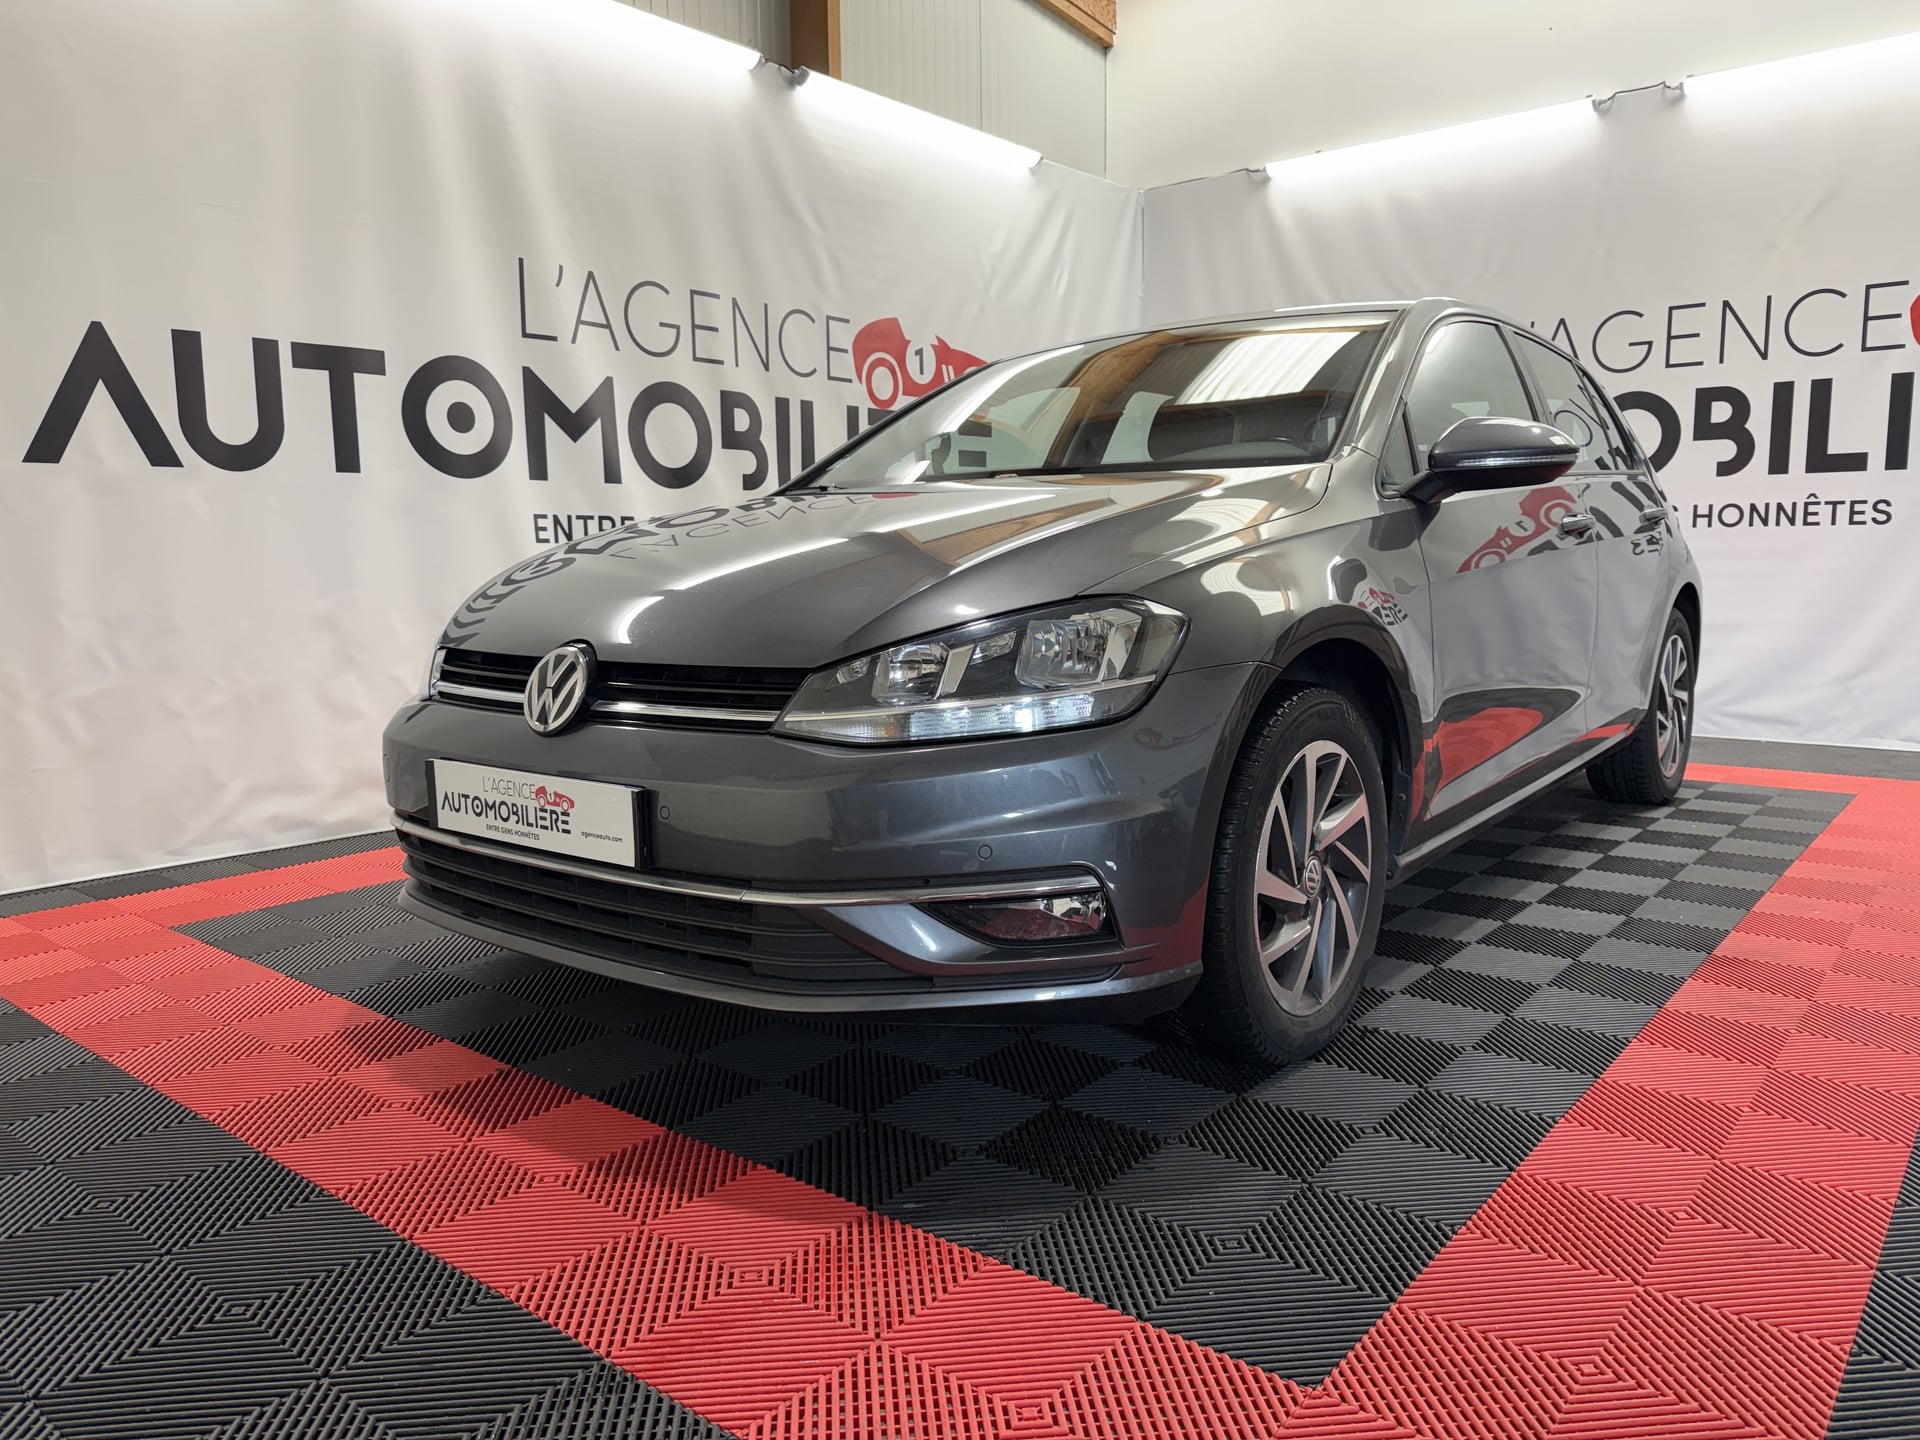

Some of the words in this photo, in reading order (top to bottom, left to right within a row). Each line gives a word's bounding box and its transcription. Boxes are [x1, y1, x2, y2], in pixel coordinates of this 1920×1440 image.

[518, 257, 854, 384] L'AGENCE
[1691, 493, 1893, 529] HONNÊTES
[482, 776, 536, 801] L'AGENCE
[486, 823, 501, 833] ENTRE
[501, 826, 514, 836] GENS
[580, 831, 624, 843] agenceauto.com
